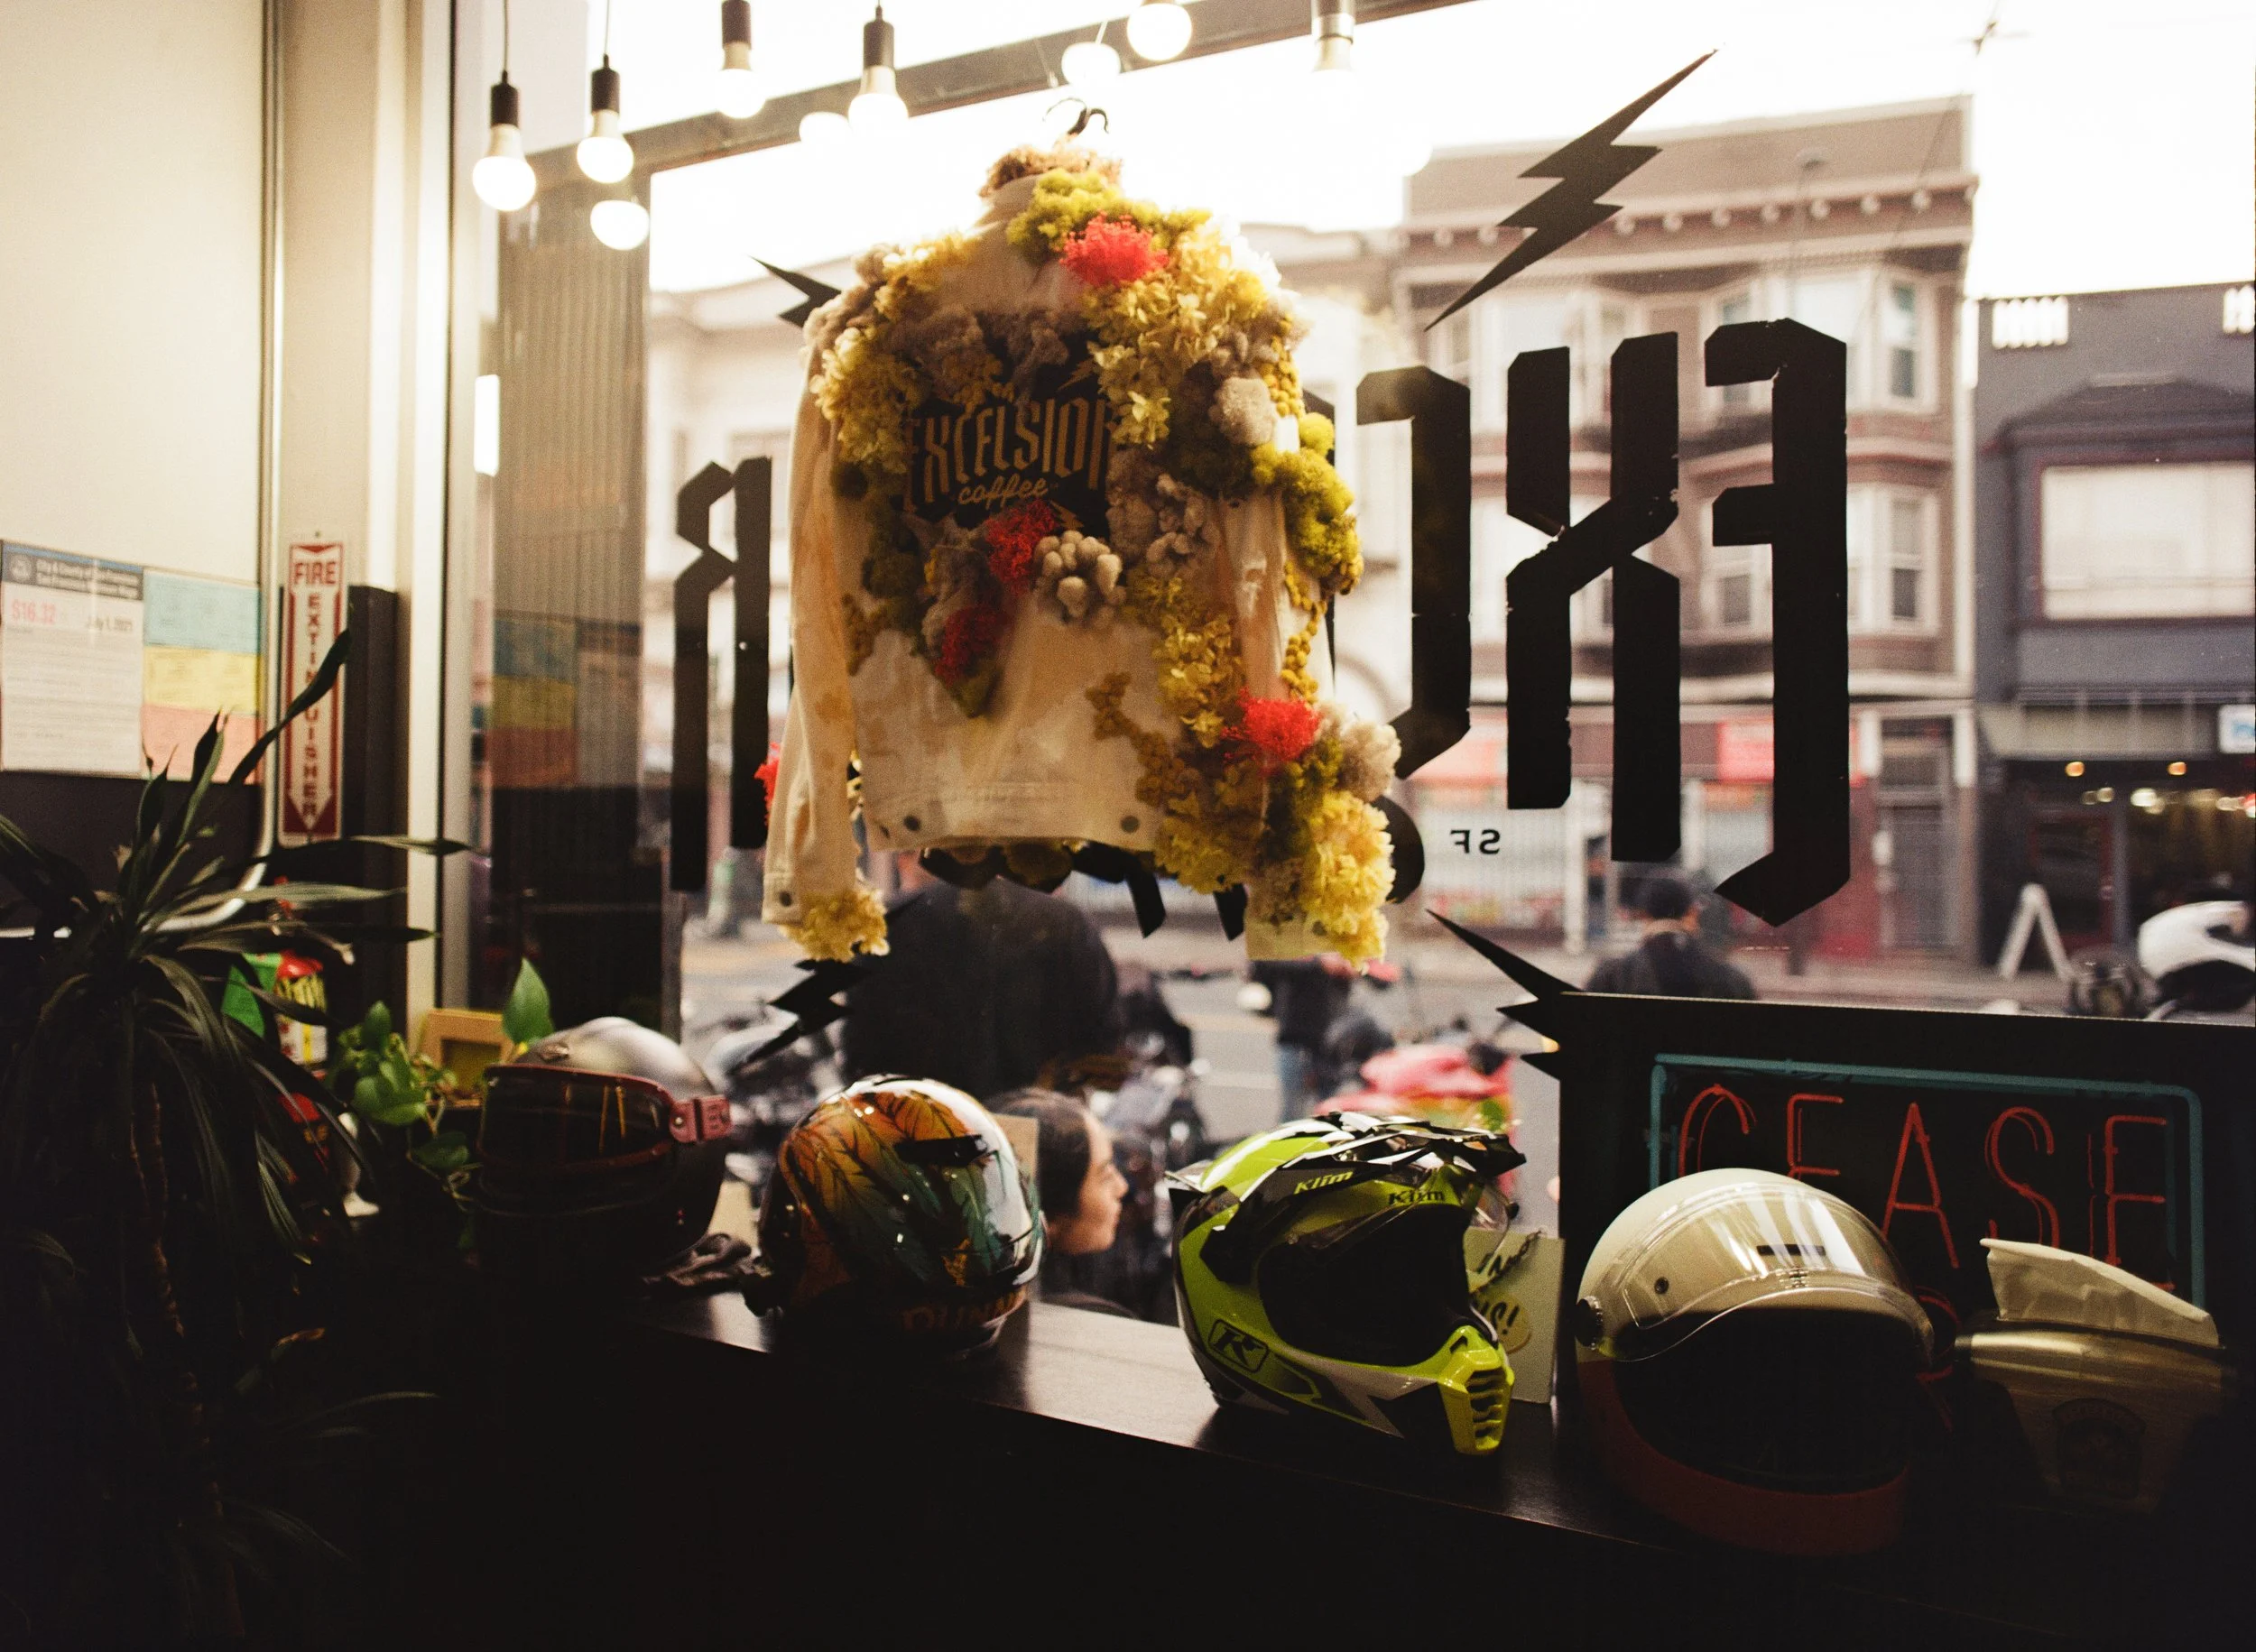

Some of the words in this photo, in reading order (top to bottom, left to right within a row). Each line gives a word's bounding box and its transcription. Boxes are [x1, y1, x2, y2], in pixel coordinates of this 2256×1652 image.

[957, 474, 1049, 511] coffee
[294, 560, 337, 585] FIRE
[1293, 1170, 1354, 1195] Klim
[1678, 1083, 2176, 1290] CEASE
